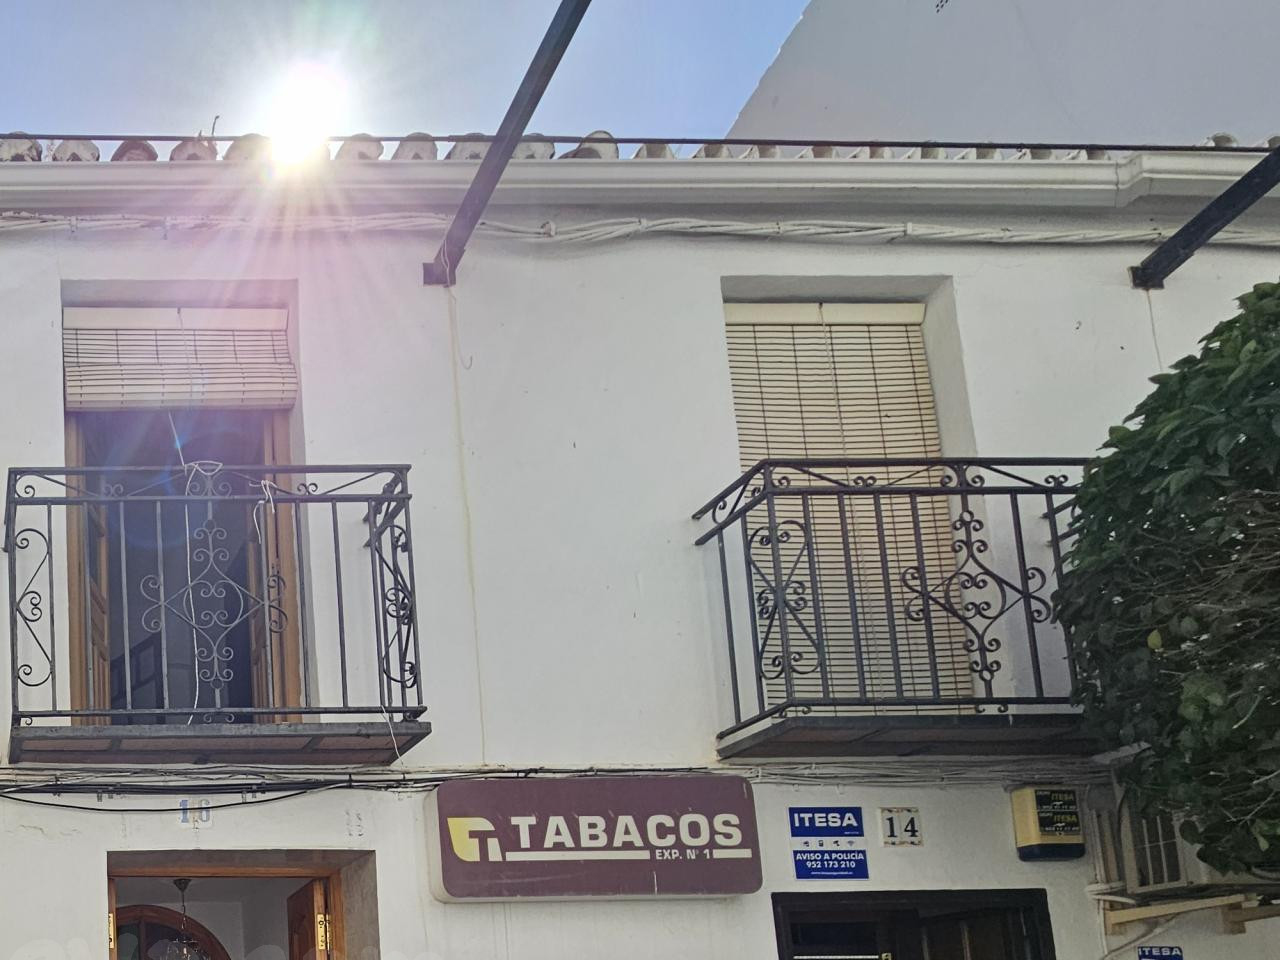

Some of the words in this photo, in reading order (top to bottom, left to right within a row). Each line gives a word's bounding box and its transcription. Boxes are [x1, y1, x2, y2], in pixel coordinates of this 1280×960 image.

[793, 812, 859, 828] ITESA
[510, 813, 743, 849] TABACOS
[885, 816, 920, 838] 14
[655, 848, 683, 861] EXP.
[703, 848, 711, 860] 1
[796, 852, 822, 861] AVISO
[823, 852, 831, 860] A
[806, 860, 822, 869] 952
[823, 860, 840, 868] 173
[840, 860, 856, 868] 210
[1138, 946, 1182, 956] ITESA
